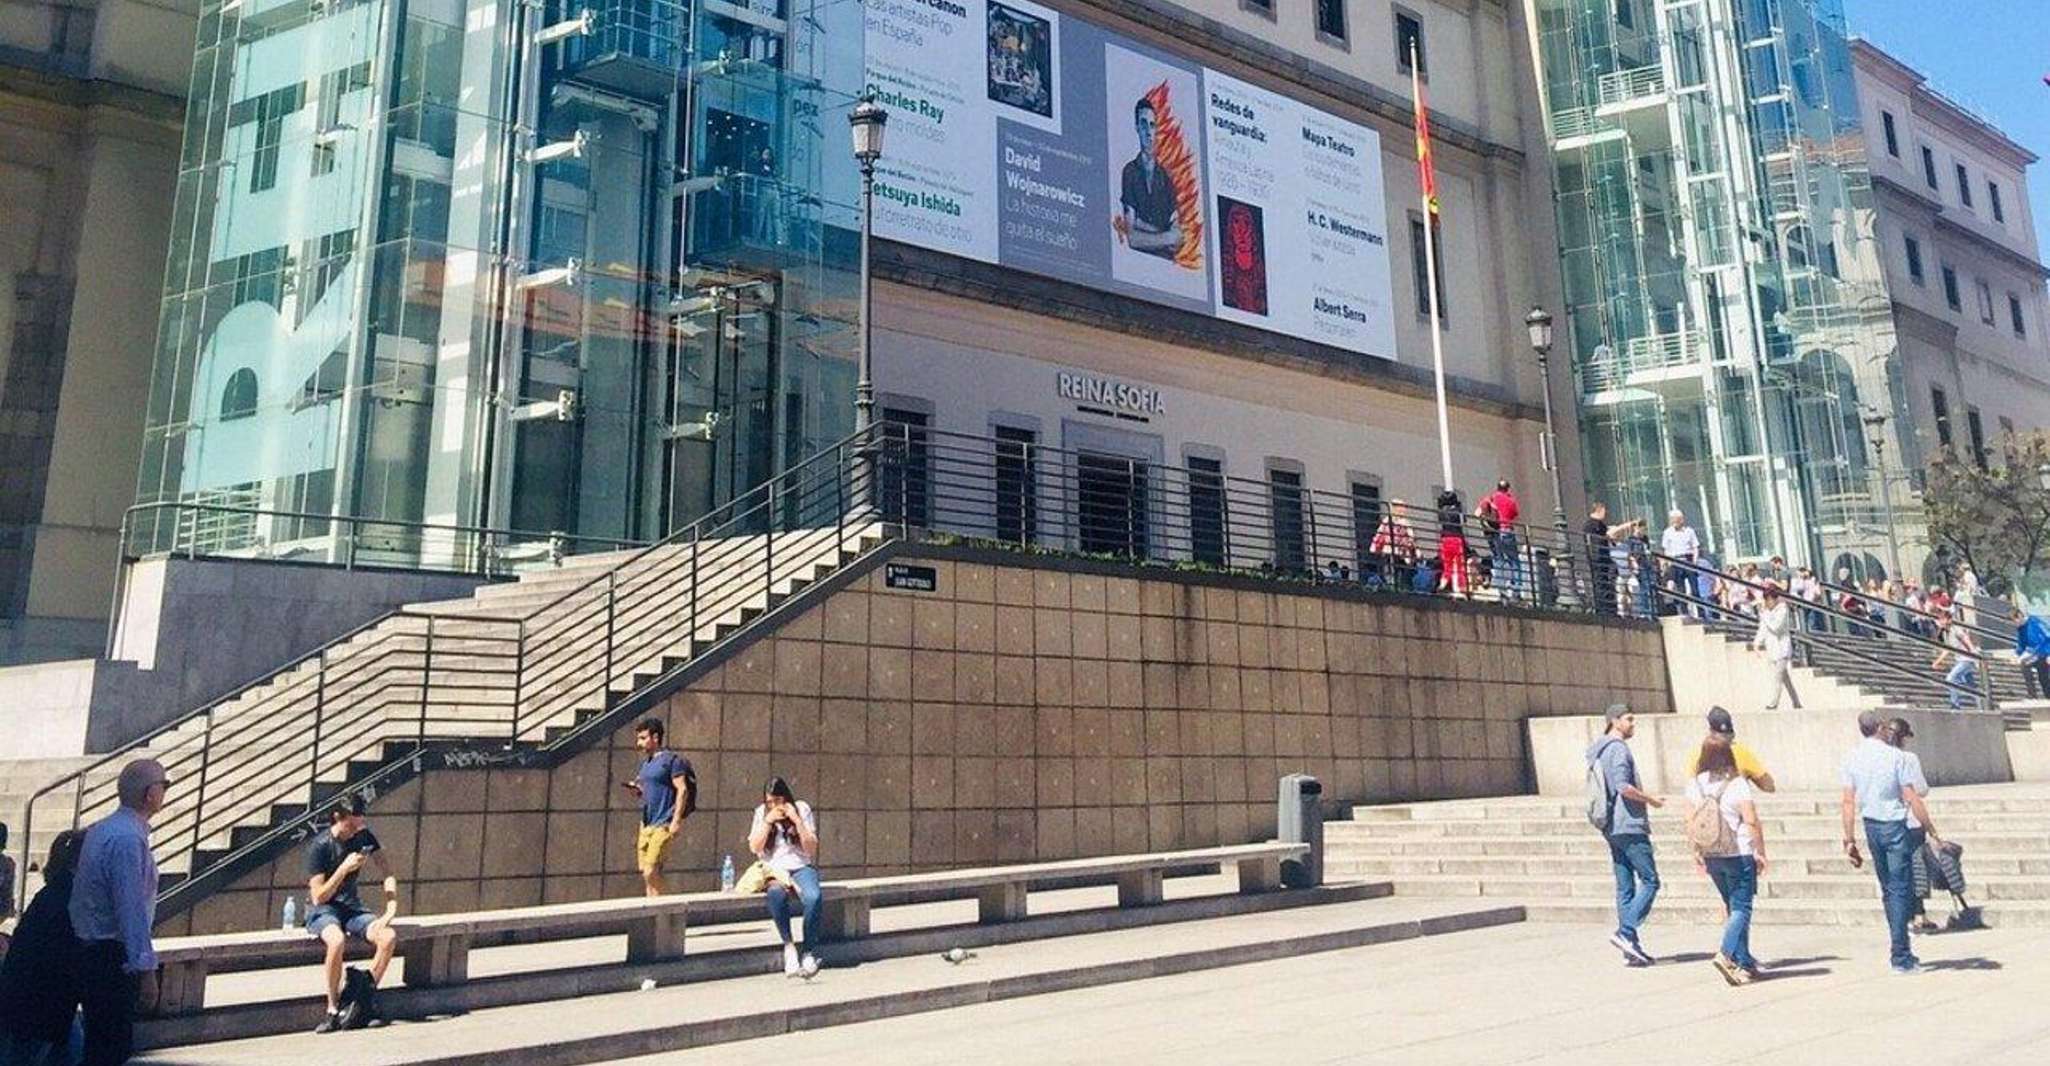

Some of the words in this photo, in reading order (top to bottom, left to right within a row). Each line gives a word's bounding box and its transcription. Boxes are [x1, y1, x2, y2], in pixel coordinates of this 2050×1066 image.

[866, 18, 880, 31] en
[866, 83, 917, 114] Charles
[919, 99, 944, 124] Ray
[1211, 93, 1241, 116] Redes
[1242, 103, 1254, 121] de
[1301, 125, 1326, 148] Mapa
[1327, 134, 1355, 158] Teatro
[1005, 147, 1041, 173] David
[873, 182, 918, 208] etsuya
[921, 191, 961, 217] Ishida
[1005, 171, 1086, 208] Wojnarowicz
[1307, 209, 1318, 226] H.
[1330, 219, 1384, 247] Westermann
[1313, 296, 1342, 317] Albert
[1343, 304, 1367, 324] Serra
[1058, 372, 1115, 405] REINA
